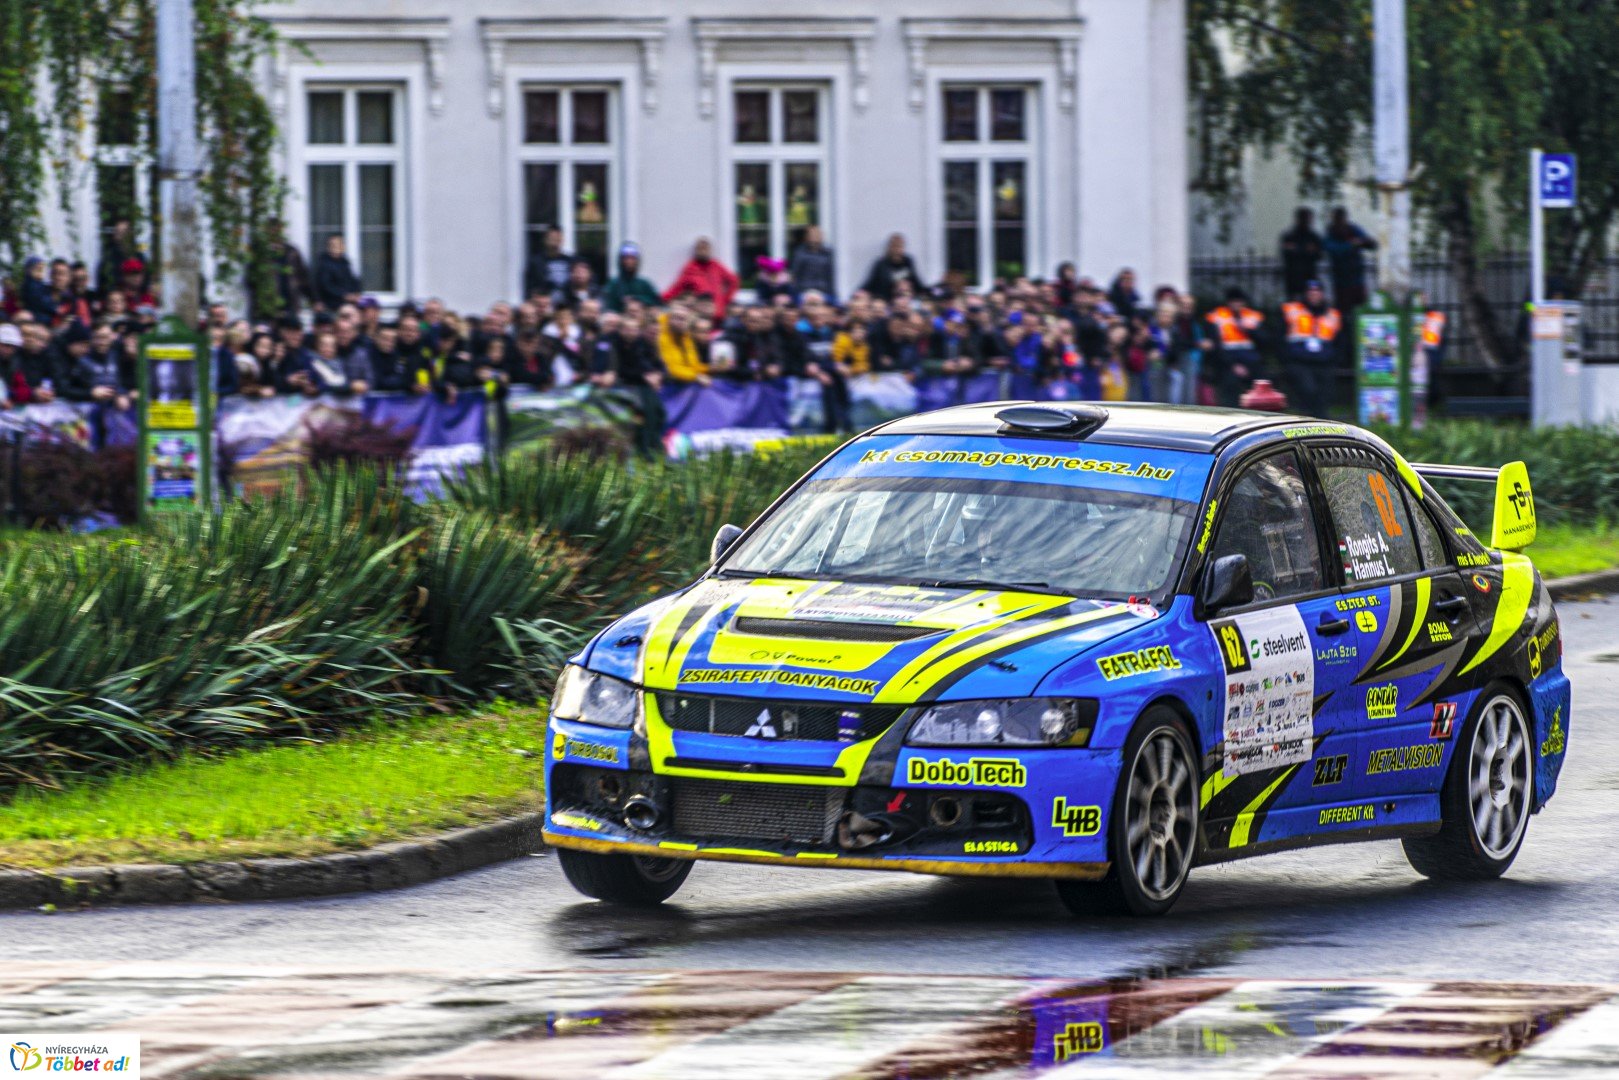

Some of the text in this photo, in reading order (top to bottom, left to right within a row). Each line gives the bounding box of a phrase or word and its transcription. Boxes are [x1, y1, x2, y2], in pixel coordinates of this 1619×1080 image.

[861, 449, 1174, 481] kt csomagexpressz.hu
[1368, 471, 1403, 538] 62
[1508, 482, 1534, 520] TST
[1346, 532, 1390, 559] Rongits A.
[1352, 554, 1395, 581] Hannus L.
[1427, 621, 1449, 635] BOMA
[1430, 633, 1453, 642] BETON
[1221, 625, 1245, 668] 62
[1263, 632, 1306, 656] steelvent
[1096, 645, 1182, 681] FATRAFOL
[908, 757, 1026, 787] DoboTech
[1312, 754, 1348, 786] ZLT
[1366, 744, 1444, 775] METALVISION
[1052, 797, 1101, 836] LHB
[1319, 806, 1362, 824] DIFFERENT
